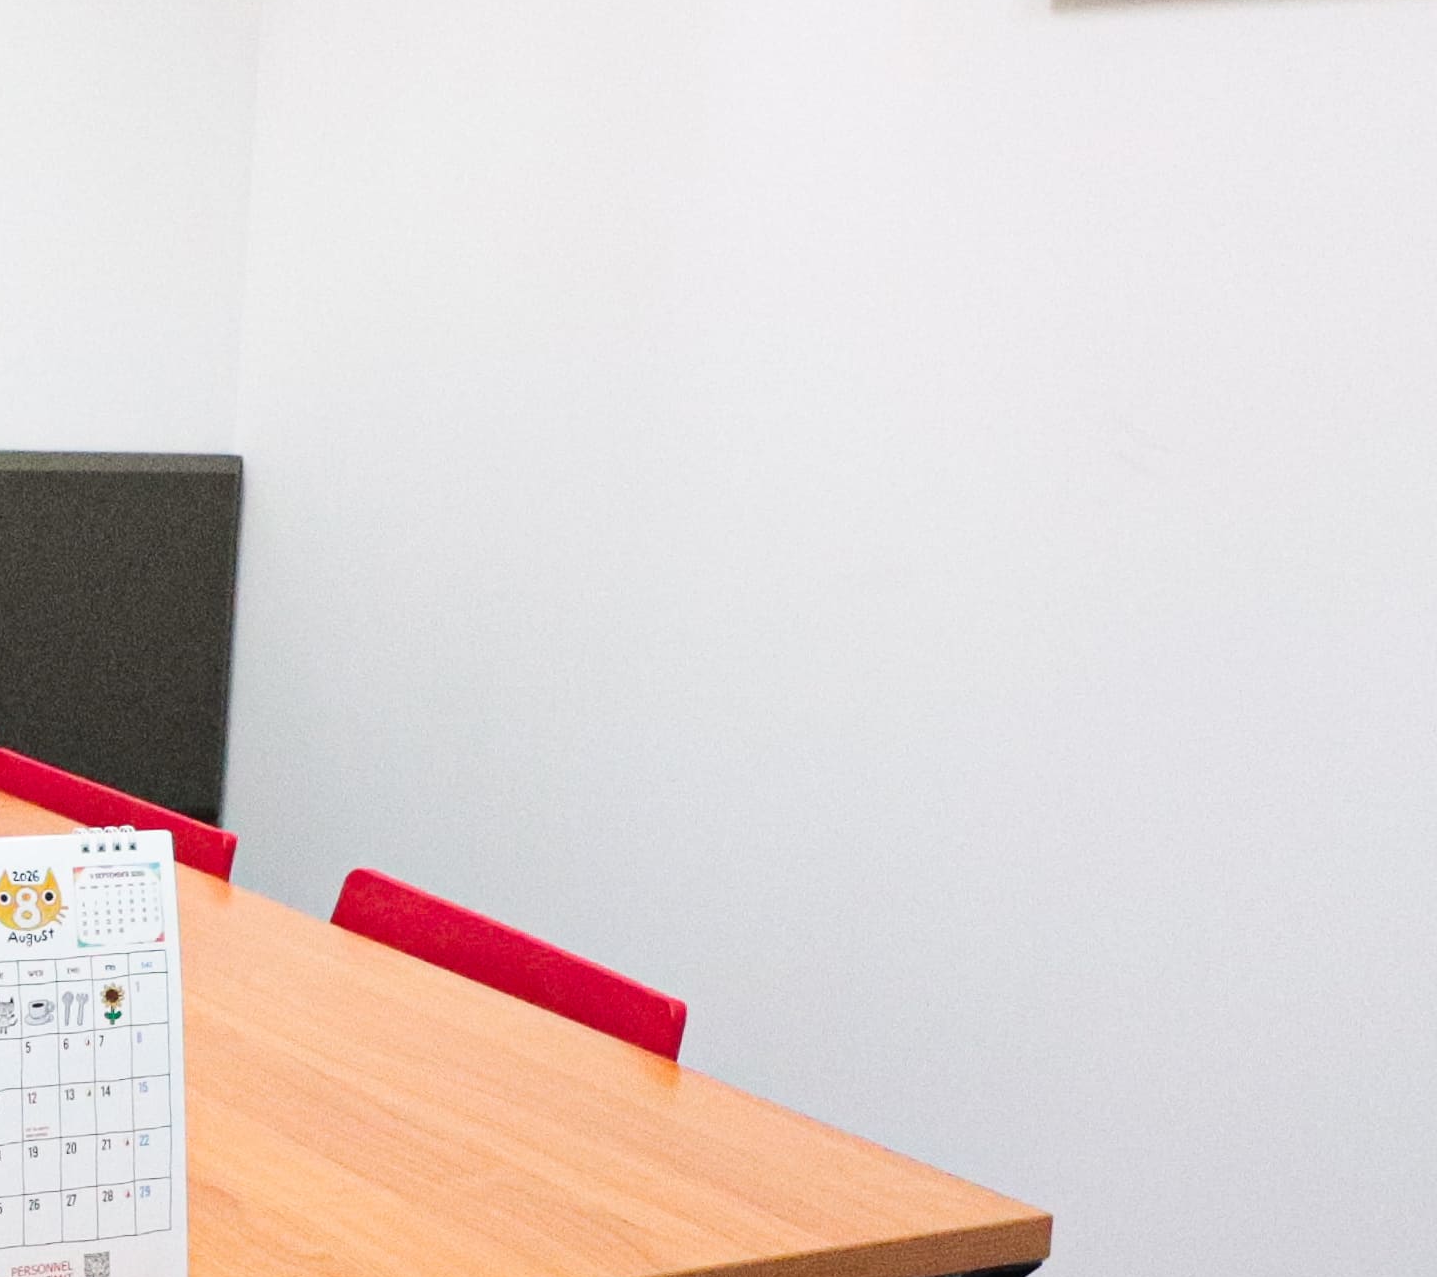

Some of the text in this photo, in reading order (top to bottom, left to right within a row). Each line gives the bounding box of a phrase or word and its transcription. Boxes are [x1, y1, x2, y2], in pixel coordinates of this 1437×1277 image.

[12, 869, 41, 883] 2026
[8, 928, 55, 947] August
[25, 1041, 32, 1054] 5
[62, 1037, 70, 1051] 6
[98, 1034, 105, 1047] 7
[27, 1091, 37, 1105] 12
[64, 1088, 76, 1101] 13
[100, 1085, 111, 1097] 14
[138, 1081, 149, 1093] 15
[28, 1145, 39, 1159] 19
[65, 1141, 77, 1155] 20
[101, 1138, 112, 1151] 21
[139, 1133, 150, 1147] 22
[28, 1198, 41, 1211] 26
[66, 1193, 77, 1207] 27
[102, 1189, 114, 1203] 28
[11, 1261, 73, 1277] PERSONNEL
